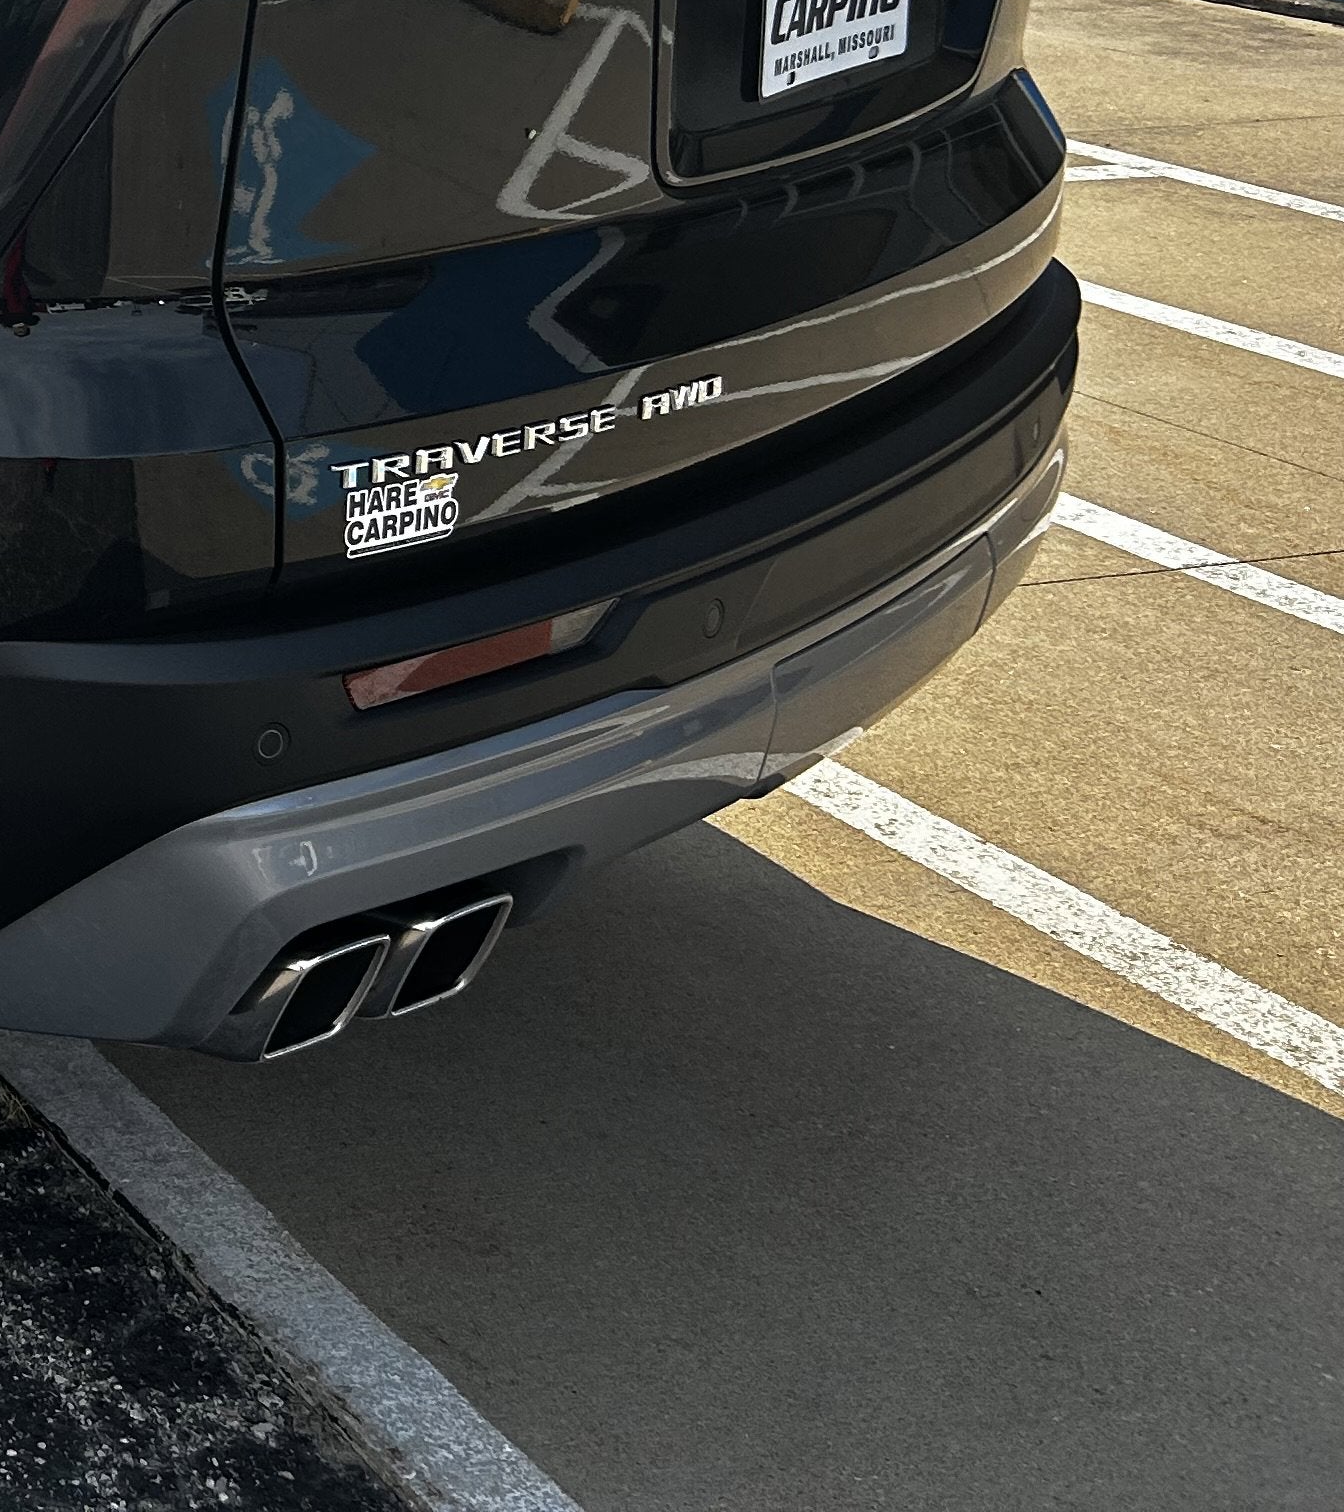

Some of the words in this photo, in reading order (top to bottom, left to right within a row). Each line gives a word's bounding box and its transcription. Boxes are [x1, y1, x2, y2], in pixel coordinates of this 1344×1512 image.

[774, 44, 835, 76] MARSHALL,
[838, 23, 896, 56] MISSOURI
[330, 405, 617, 489] TRAVERSE
[640, 374, 723, 420] AWD
[346, 500, 457, 546] CARPINO
[348, 482, 418, 519] HARE
